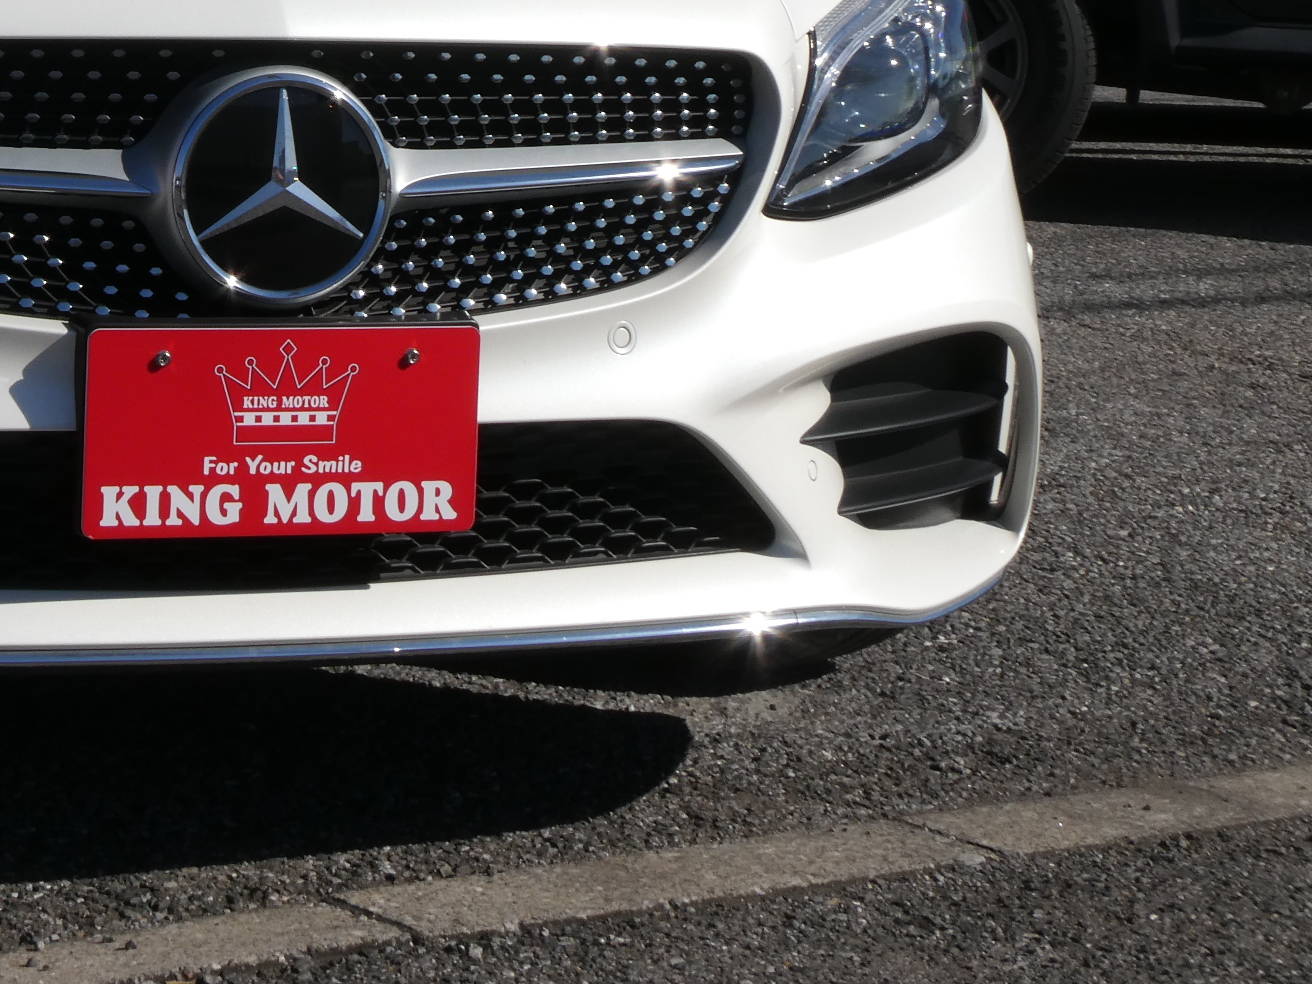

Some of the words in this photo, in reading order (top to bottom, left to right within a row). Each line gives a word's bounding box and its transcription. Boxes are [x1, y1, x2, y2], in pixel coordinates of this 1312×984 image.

[243, 395, 278, 409] KING
[282, 395, 329, 408] MOTOR
[203, 456, 238, 475] For
[245, 454, 296, 475] Your
[301, 454, 362, 475] Smile
[99, 483, 243, 527] KING
[263, 480, 458, 524] MOTOR
